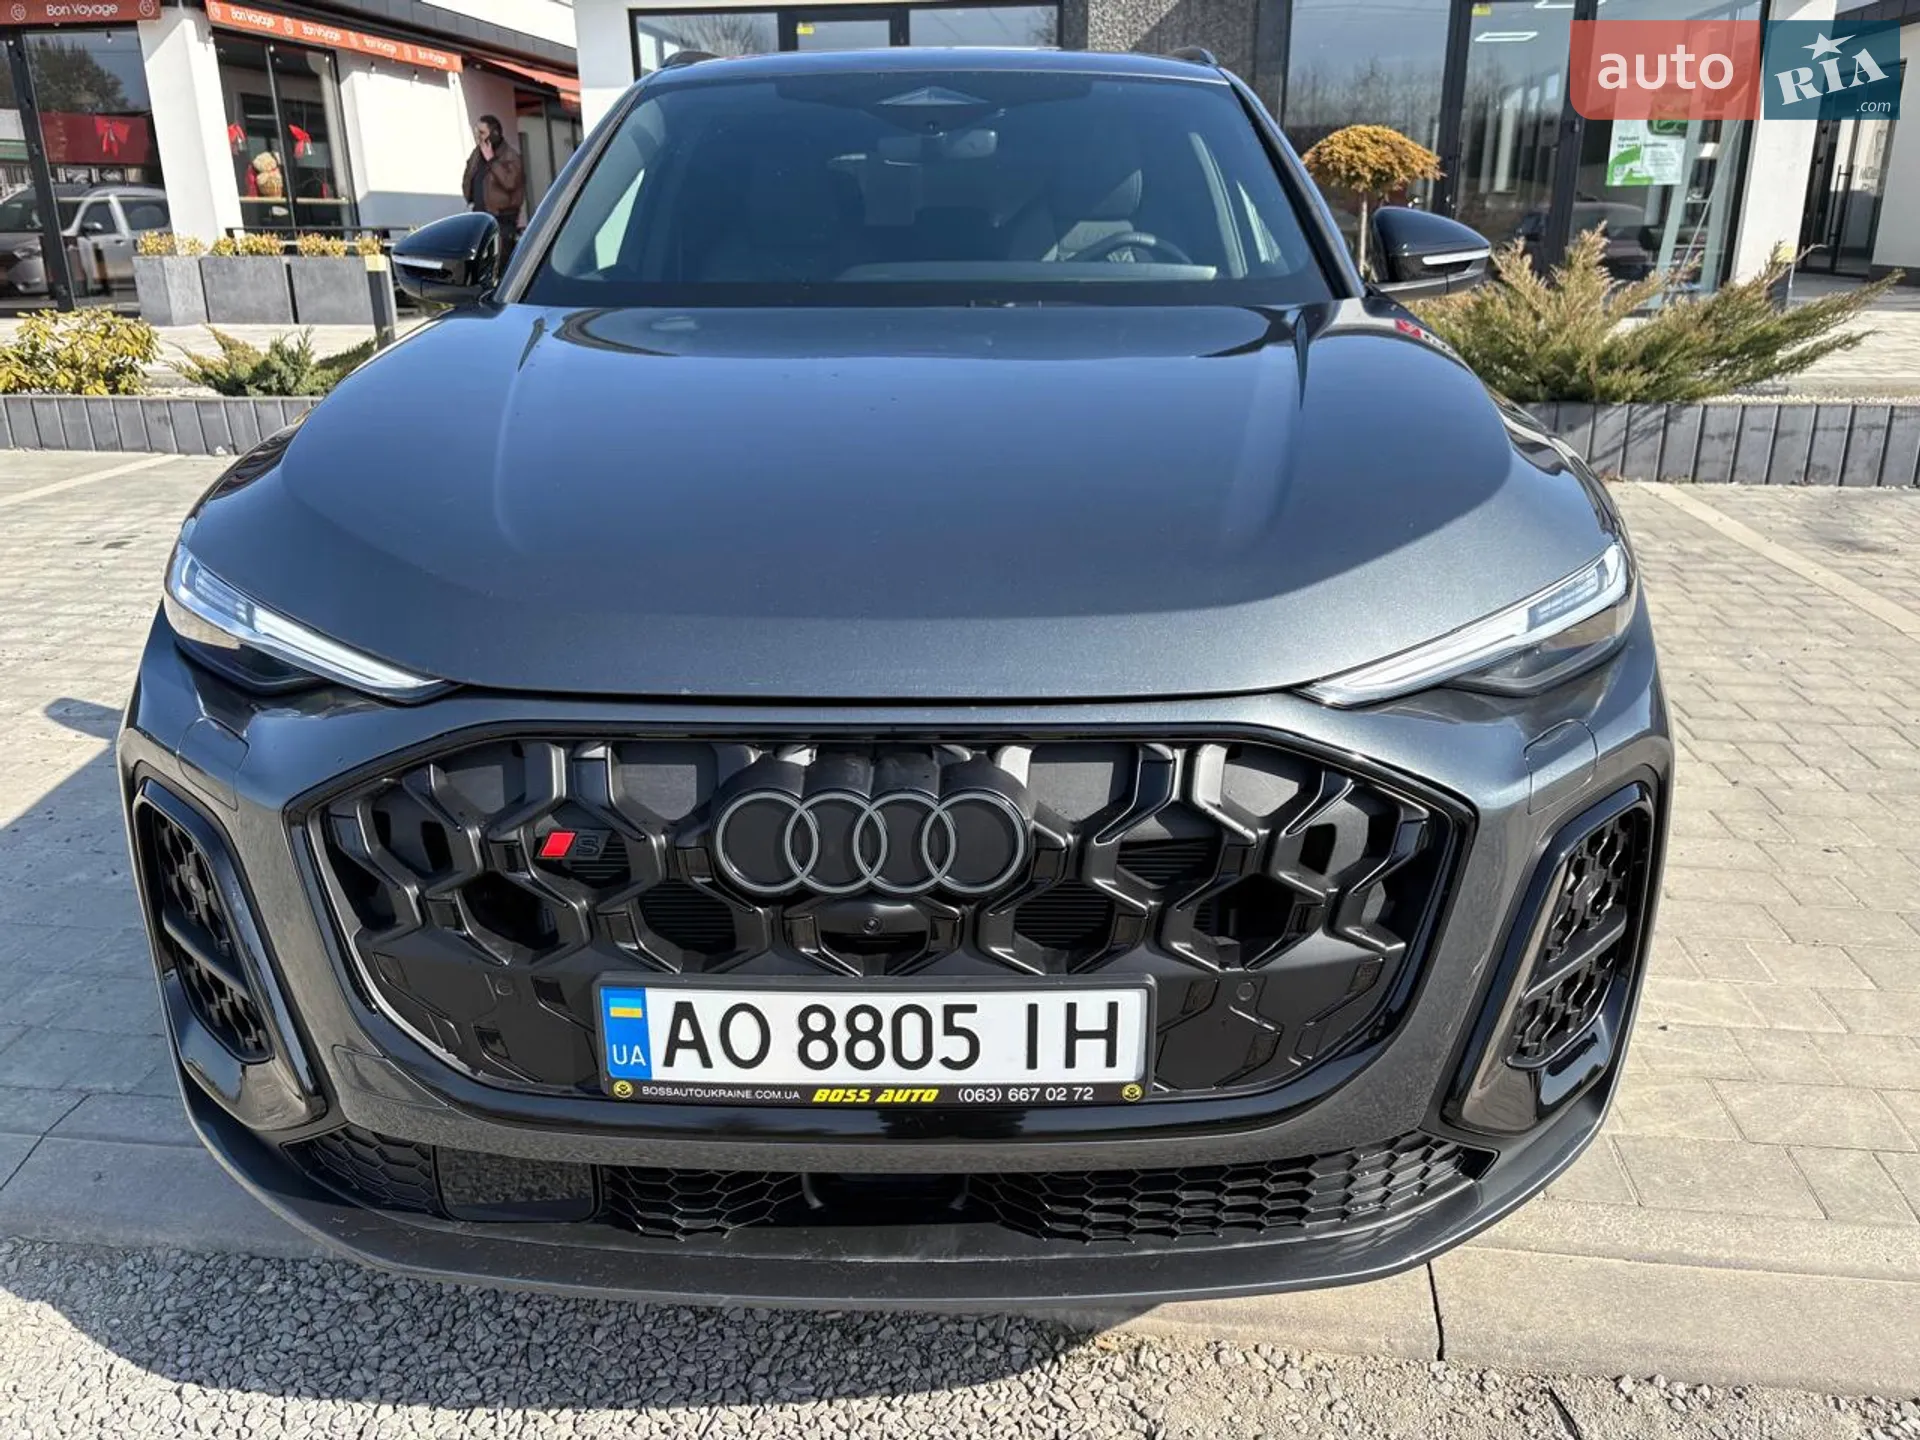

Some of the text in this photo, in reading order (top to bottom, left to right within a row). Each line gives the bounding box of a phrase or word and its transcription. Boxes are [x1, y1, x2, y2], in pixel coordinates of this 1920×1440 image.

[46, 3, 118, 17] Bon Voyage
[662, 1000, 1119, 1071] AO 8805 IH
[612, 1043, 647, 1067] UA
[641, 1085, 801, 1100] BOSSAUTOUKRAINE.COM.UA
[812, 1088, 940, 1104] BOSS AUTO
[957, 1086, 1095, 1103] (063) 667 02 72
